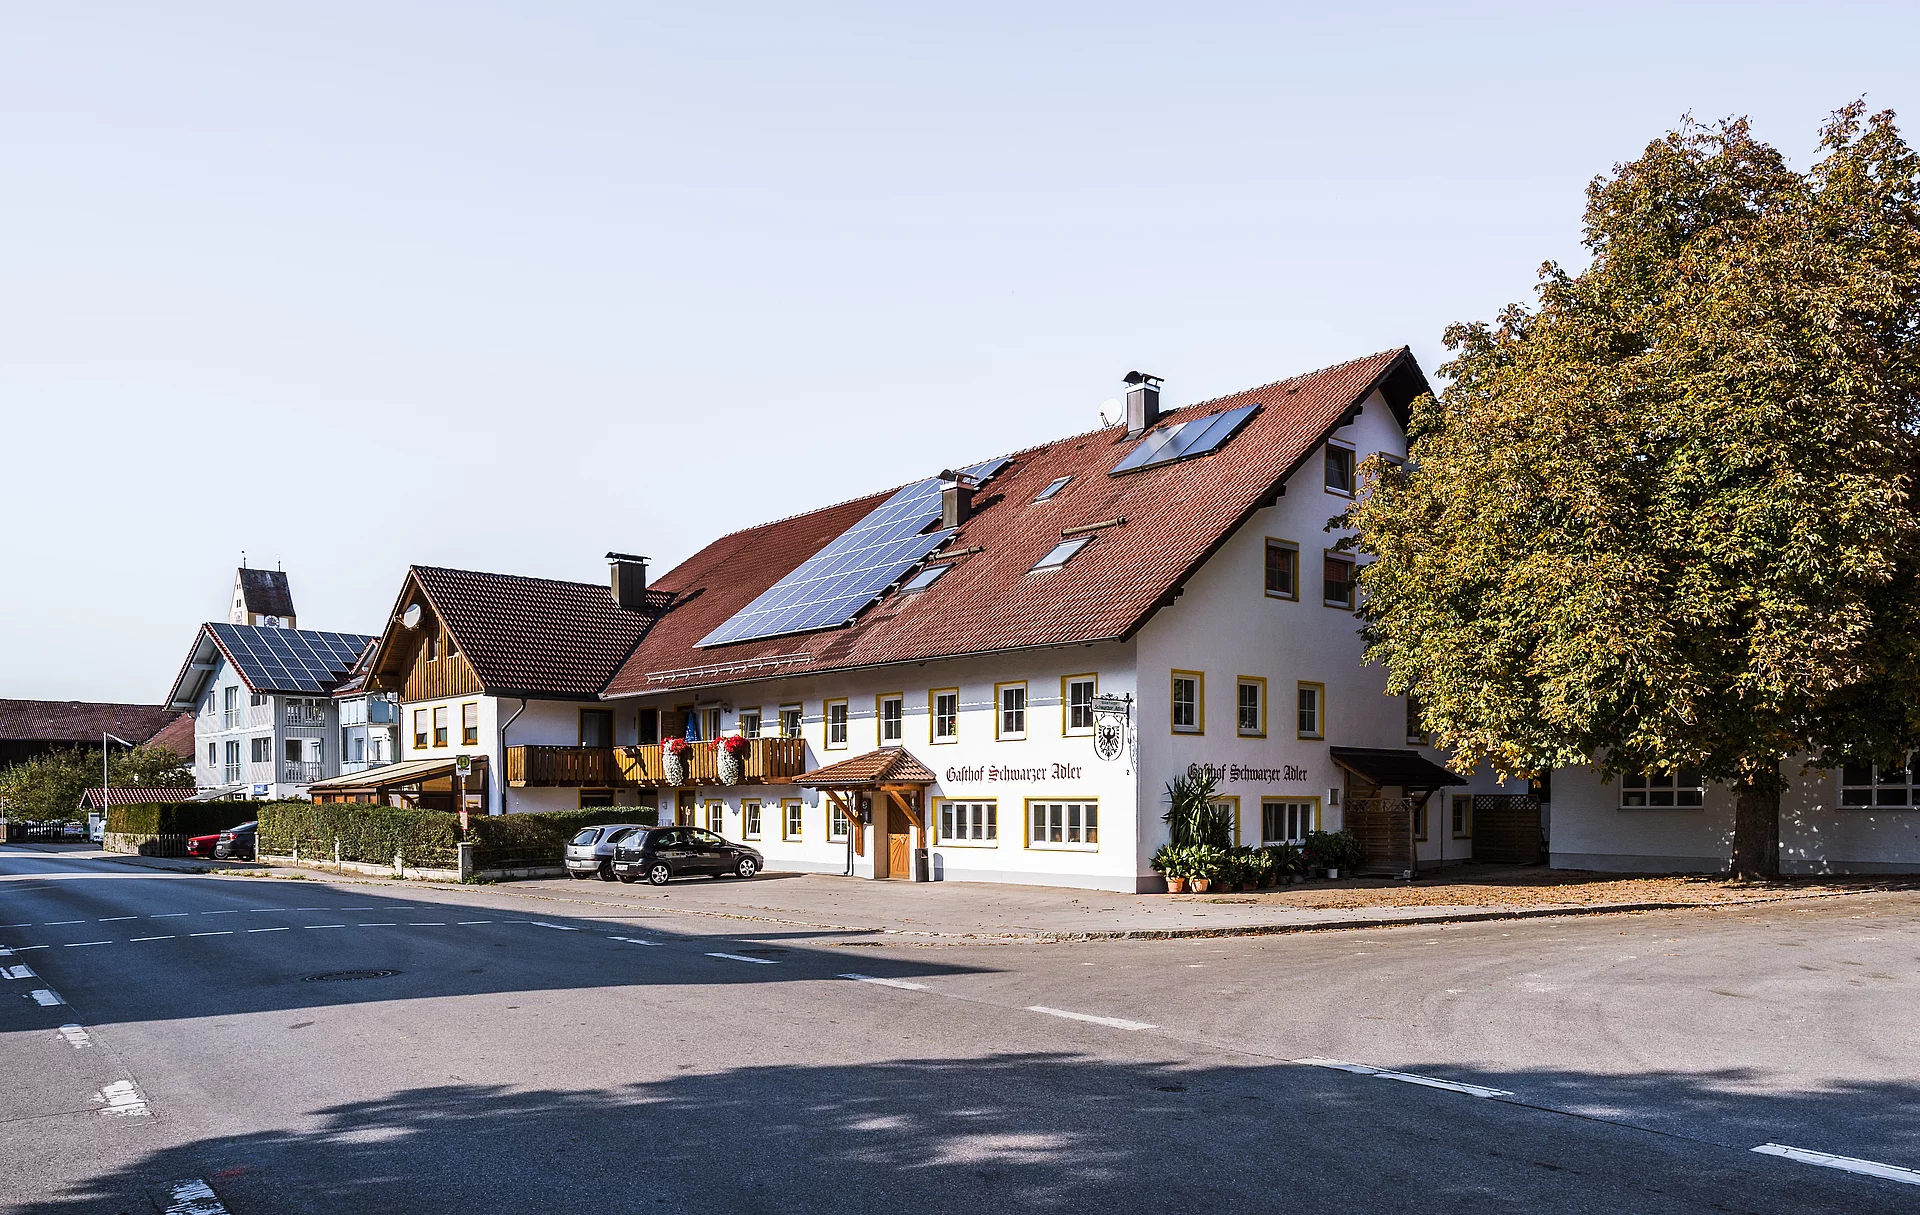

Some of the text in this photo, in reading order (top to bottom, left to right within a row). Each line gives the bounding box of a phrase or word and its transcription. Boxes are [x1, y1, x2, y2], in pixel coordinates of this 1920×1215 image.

[988, 764, 1047, 784] Schwarzer
[1051, 763, 1082, 780] Adler
[1229, 763, 1280, 784] Schwarzer
[1283, 765, 1308, 781] Adler
